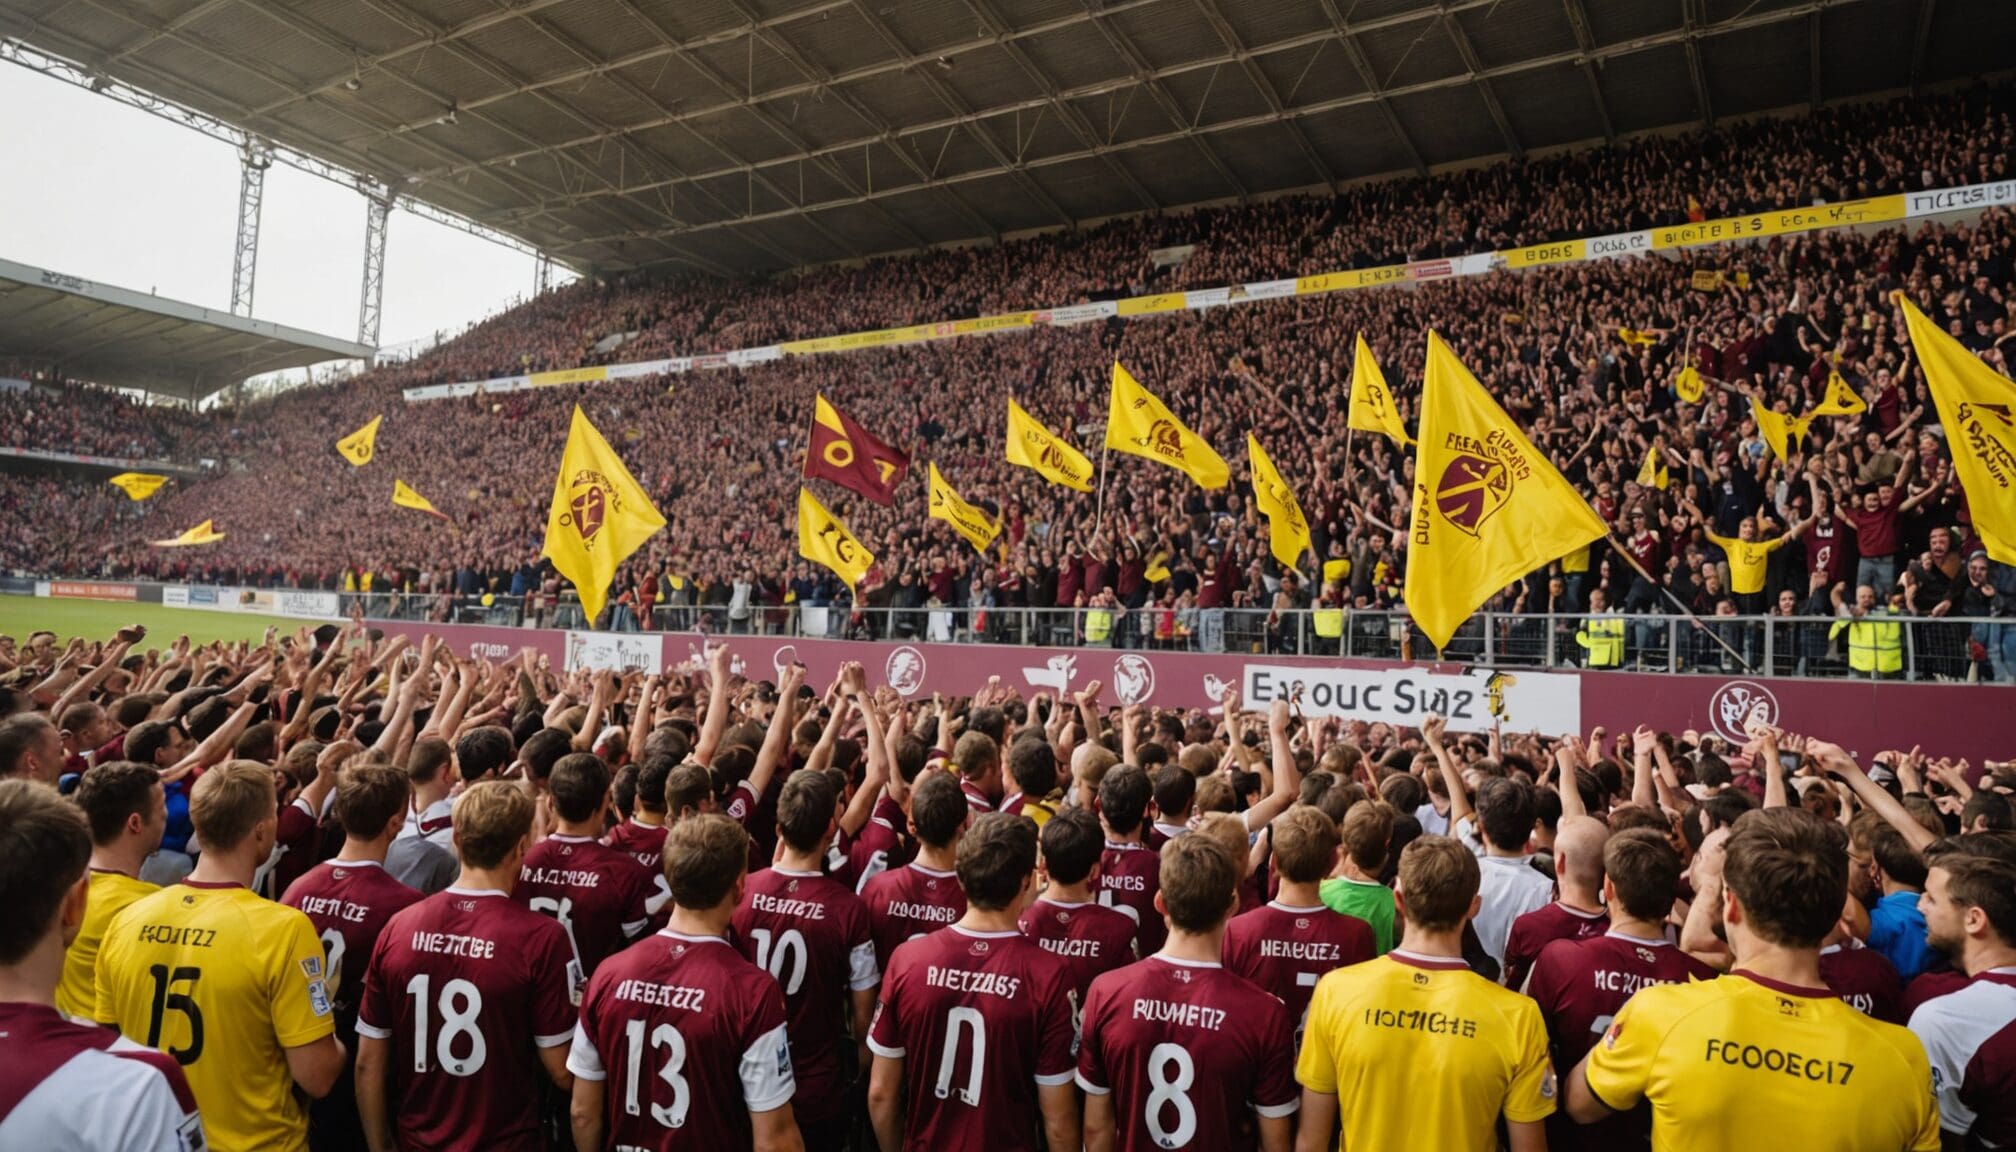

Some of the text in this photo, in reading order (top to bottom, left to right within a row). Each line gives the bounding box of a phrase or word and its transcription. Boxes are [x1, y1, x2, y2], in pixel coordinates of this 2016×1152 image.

[147, 963, 205, 1067] 15
[406, 973, 487, 1077] 18
[625, 1018, 691, 1129] 13
[1144, 1042, 1198, 1150] 8
